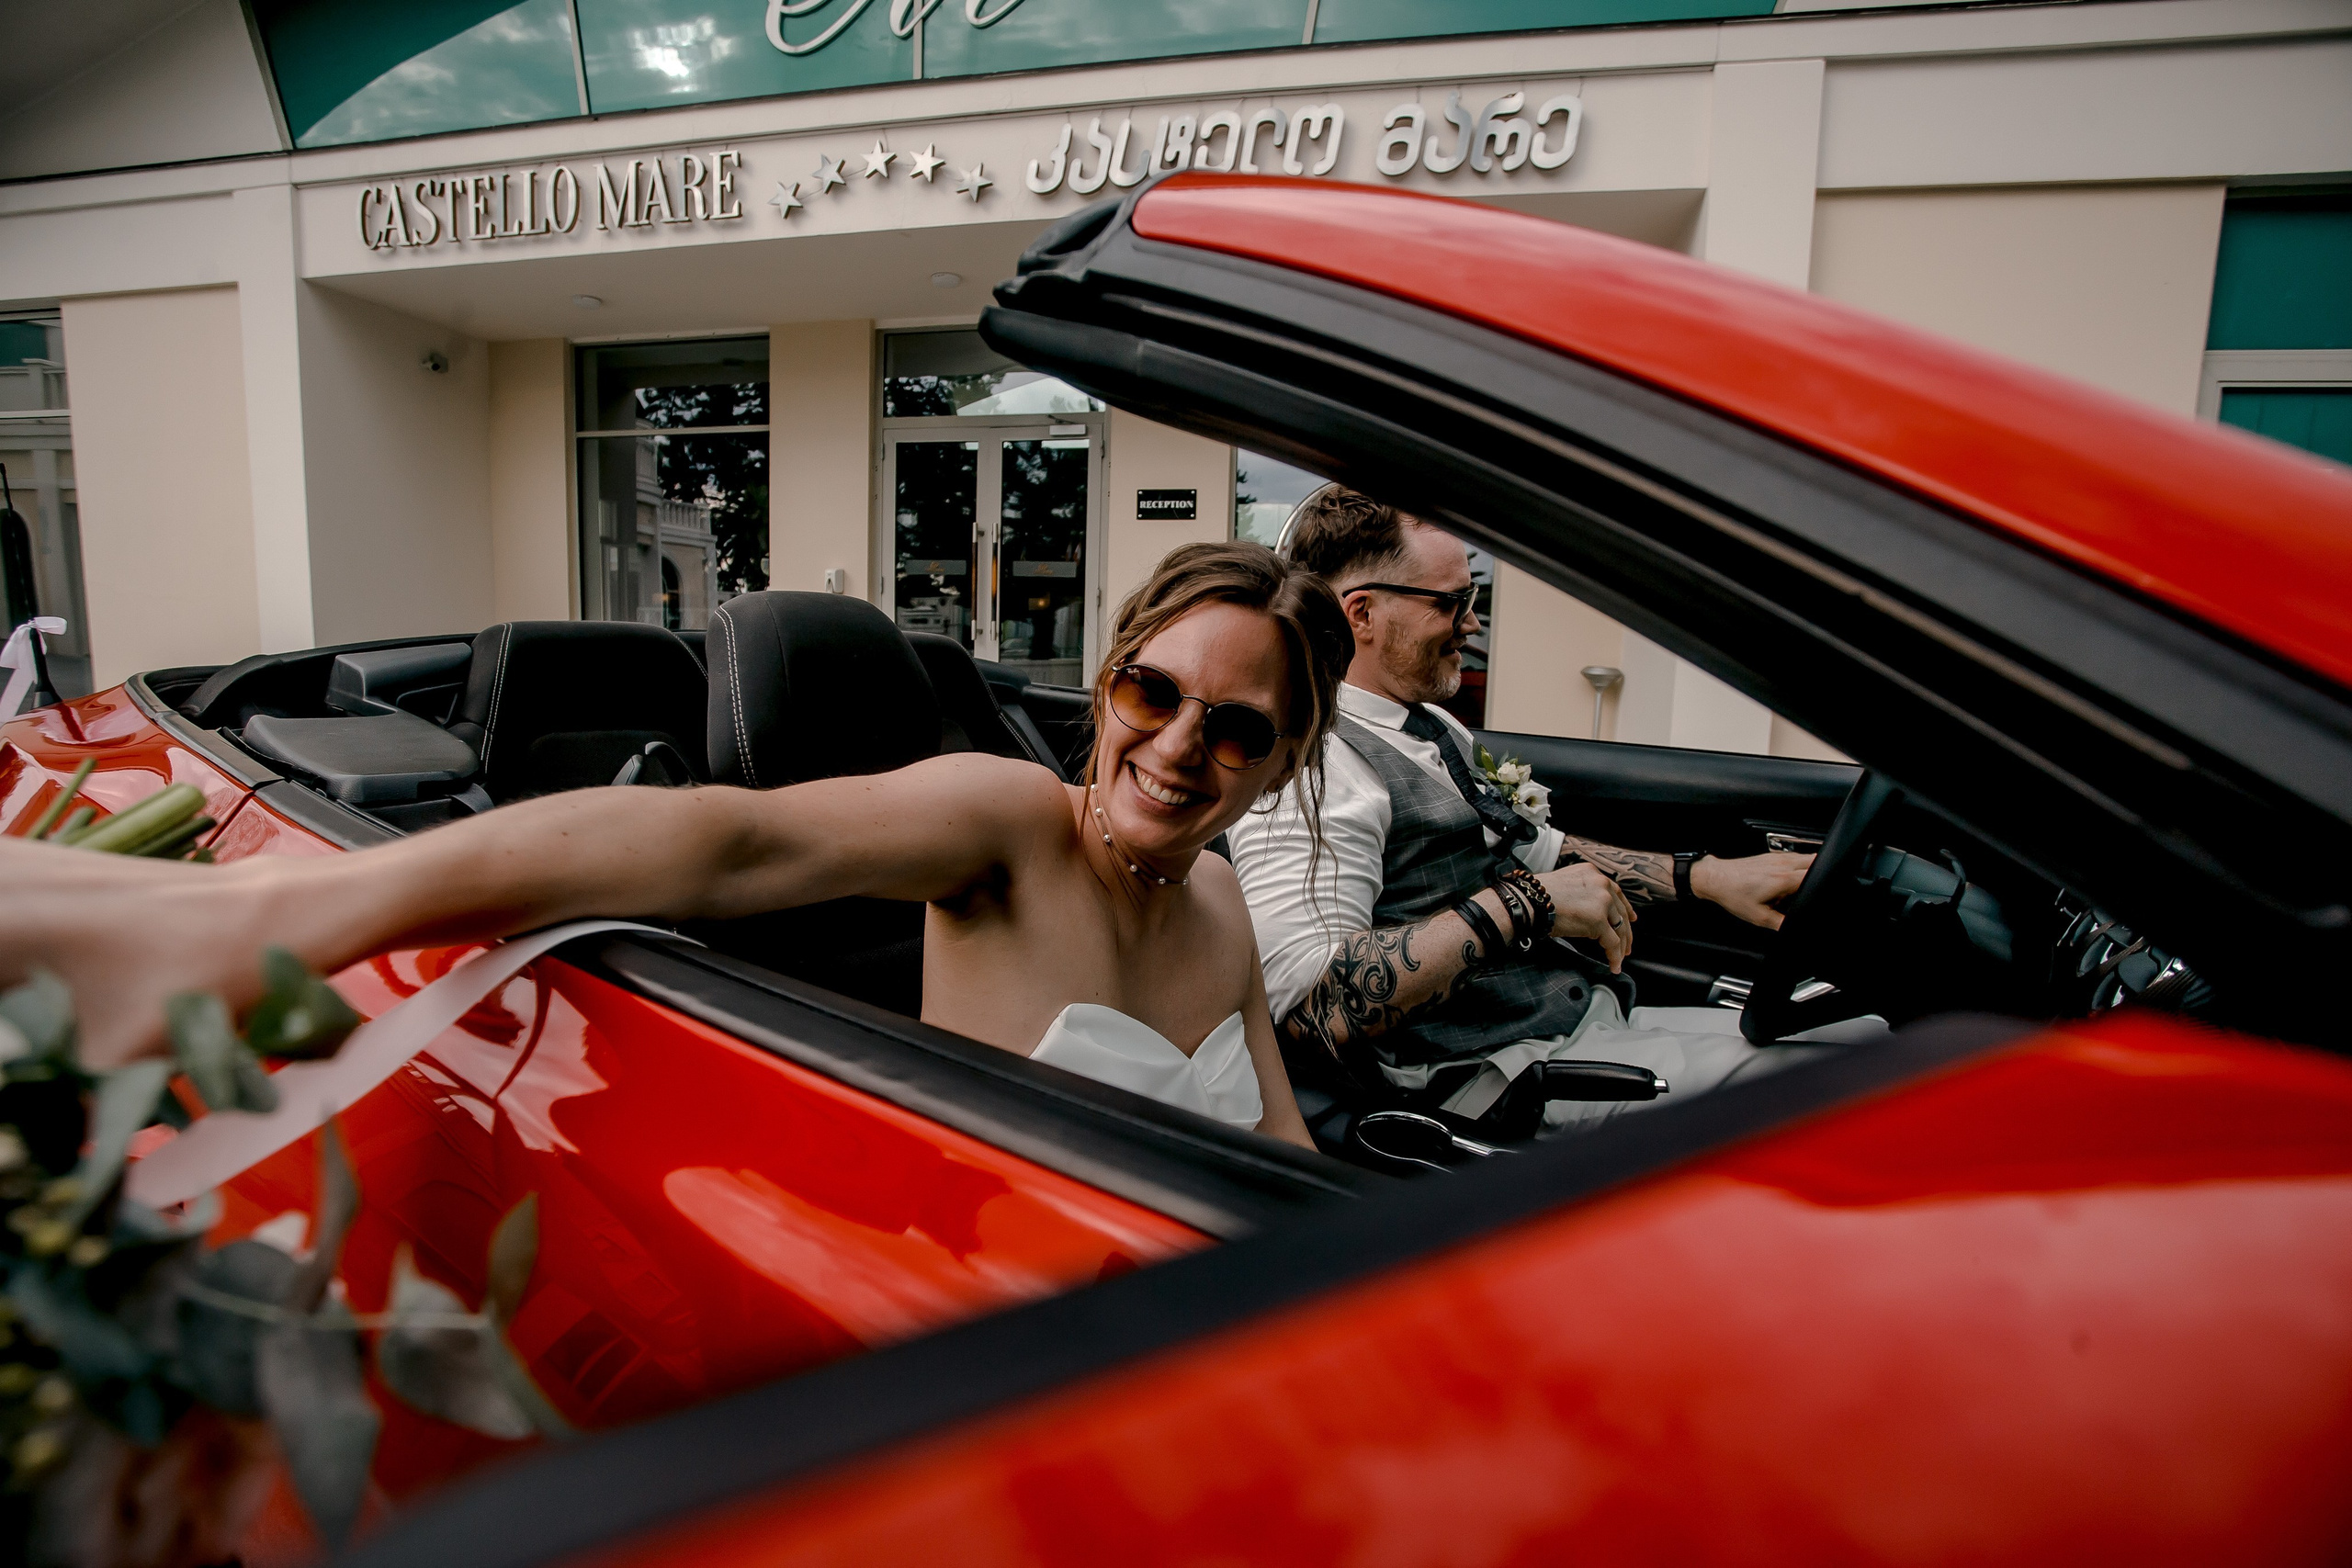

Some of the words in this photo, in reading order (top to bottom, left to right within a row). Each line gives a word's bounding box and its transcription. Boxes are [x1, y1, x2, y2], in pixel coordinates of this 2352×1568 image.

[1025, 103, 1346, 194] კასტელო
[1376, 91, 1583, 176] მარე
[357, 165, 581, 251] CASTELLO
[594, 150, 743, 231] MARE
[1139, 501, 1194, 509] RECEPTION
